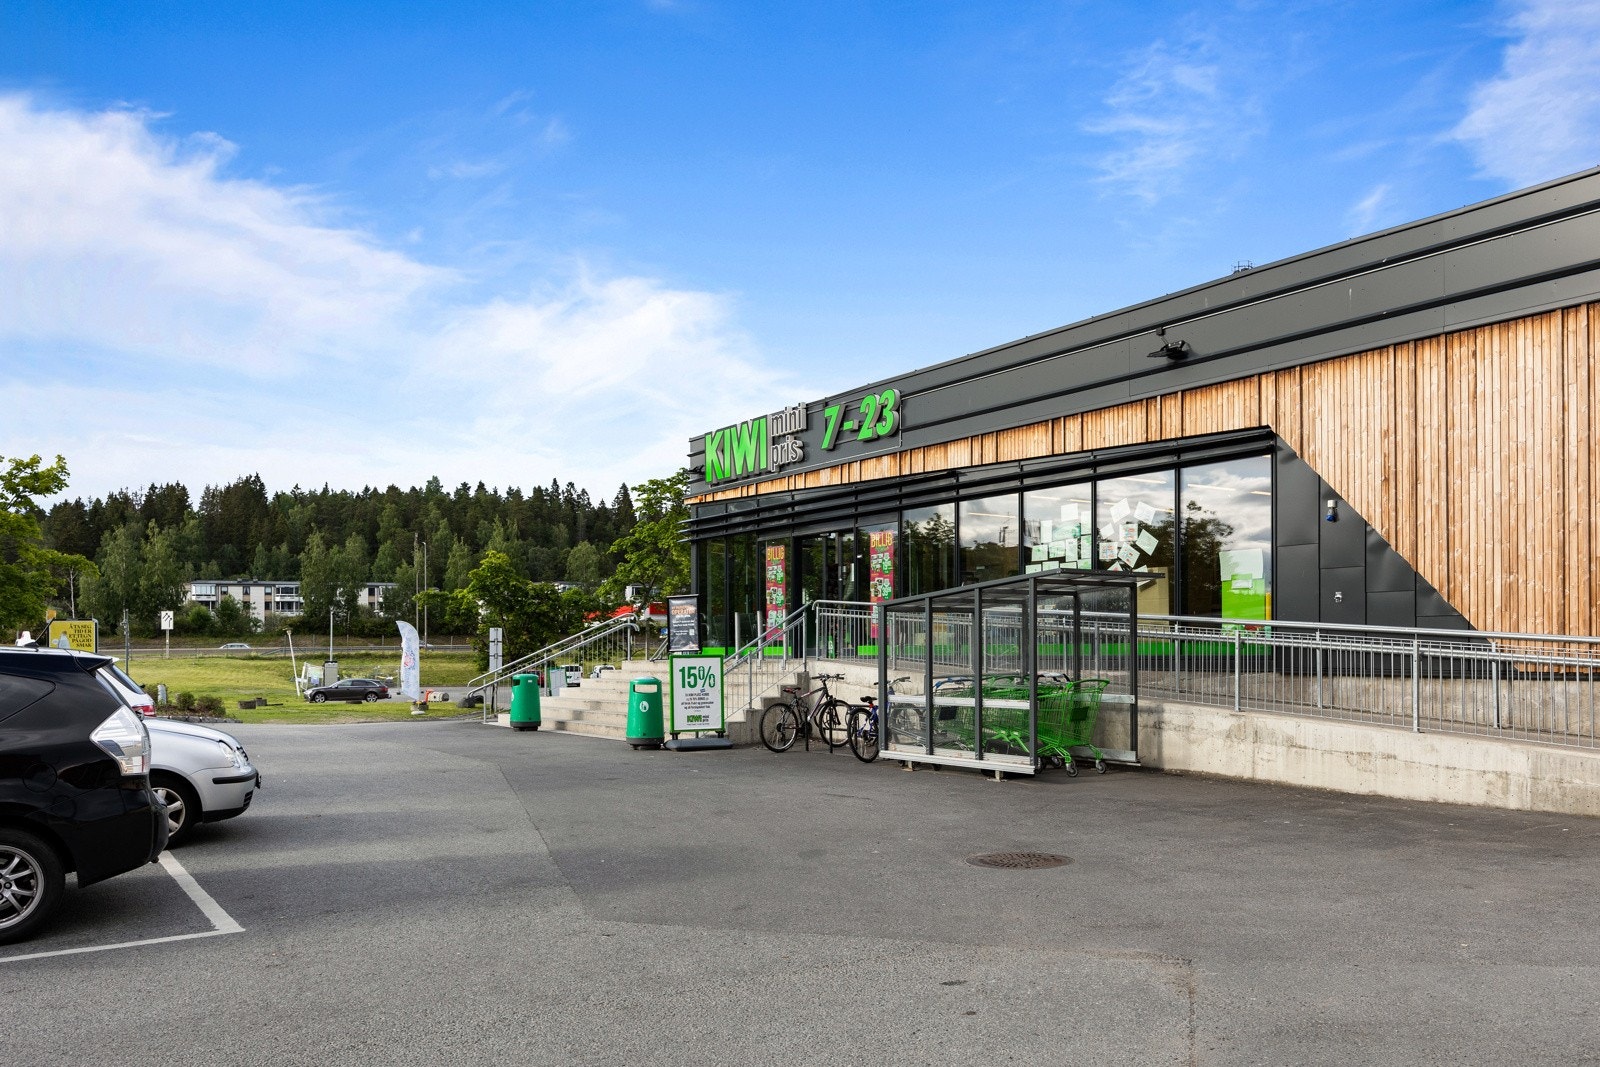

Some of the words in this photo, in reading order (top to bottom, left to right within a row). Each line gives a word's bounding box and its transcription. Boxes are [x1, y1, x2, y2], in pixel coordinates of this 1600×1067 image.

[771, 403, 806, 436] mini
[704, 416, 768, 483] KIWI
[771, 435, 803, 472] pris
[679, 666, 715, 688] 15%
[686, 714, 702, 723] KIWI
